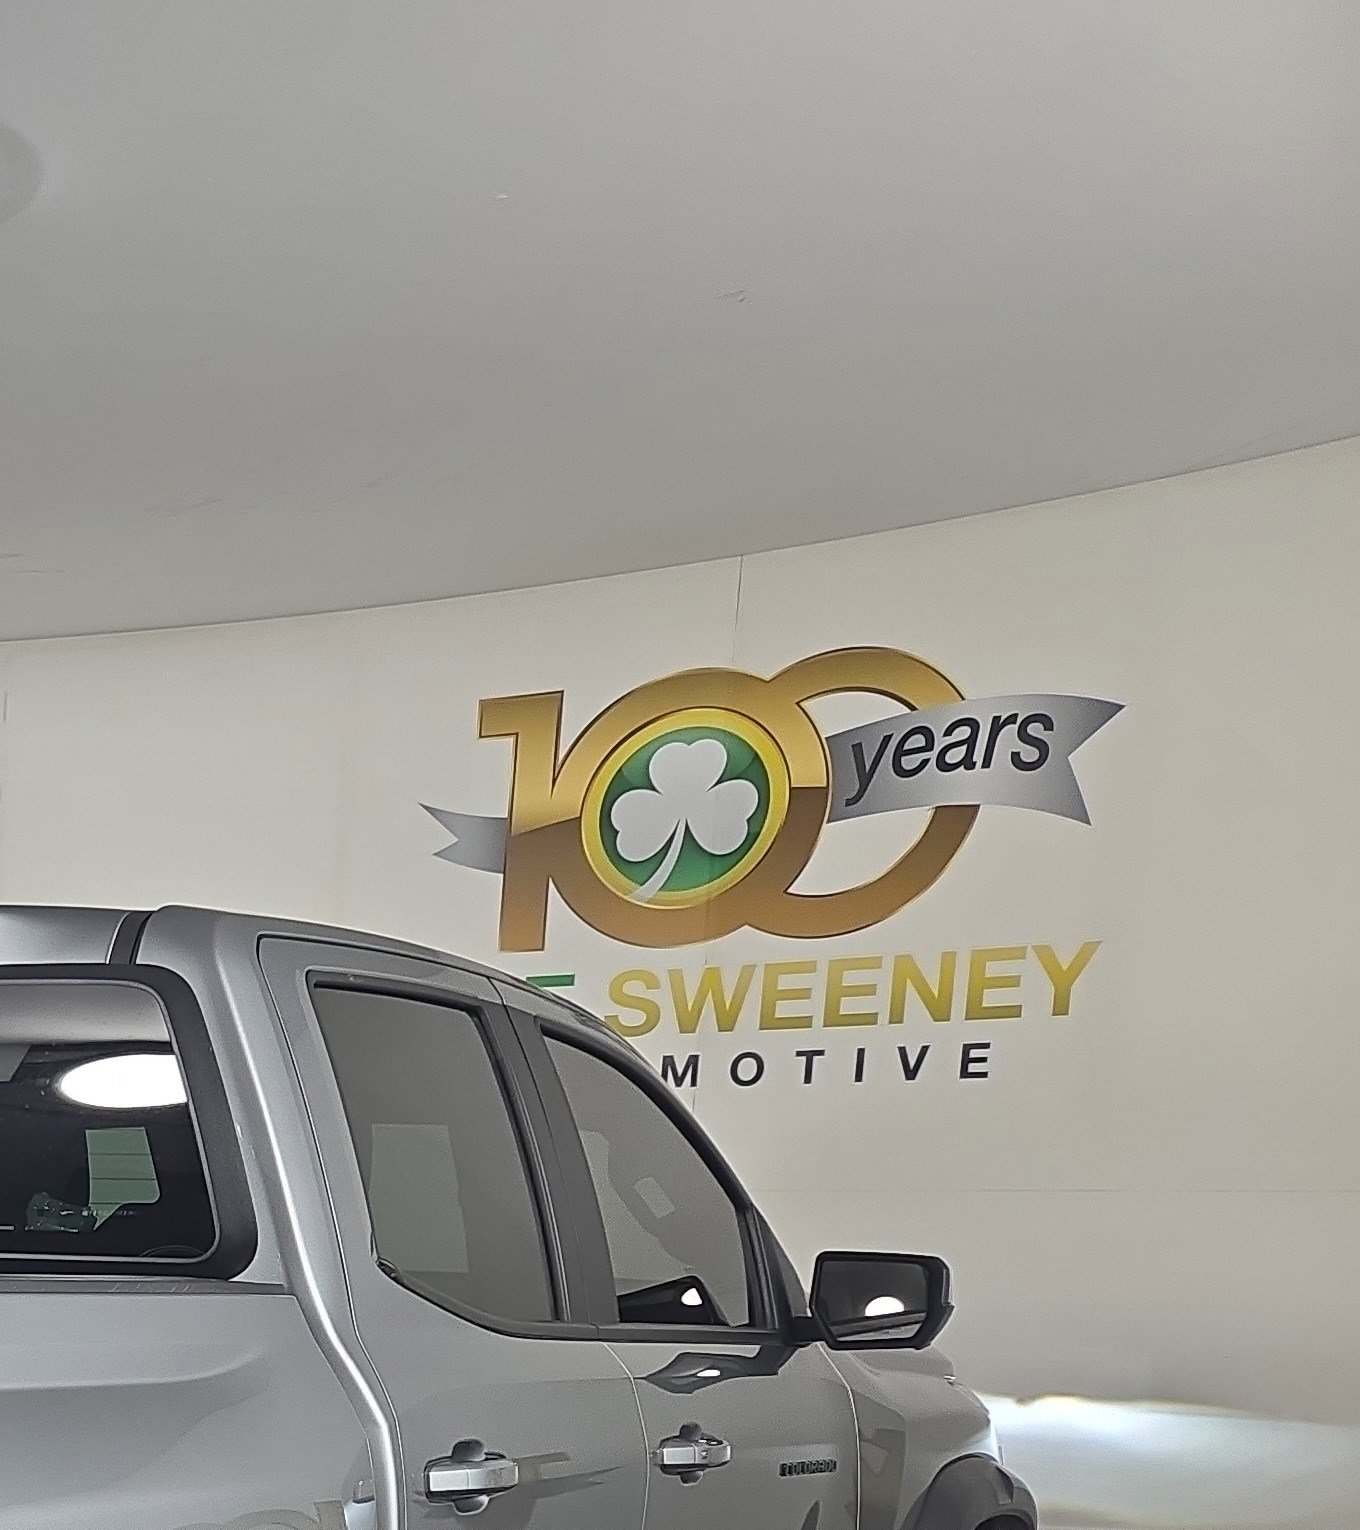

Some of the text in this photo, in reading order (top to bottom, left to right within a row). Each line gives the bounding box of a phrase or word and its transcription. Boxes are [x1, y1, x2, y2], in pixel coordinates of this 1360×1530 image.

[844, 711, 1055, 808] years
[604, 940, 1103, 1038] SWEENEY
[660, 1042, 991, 1088] MOTIVE
